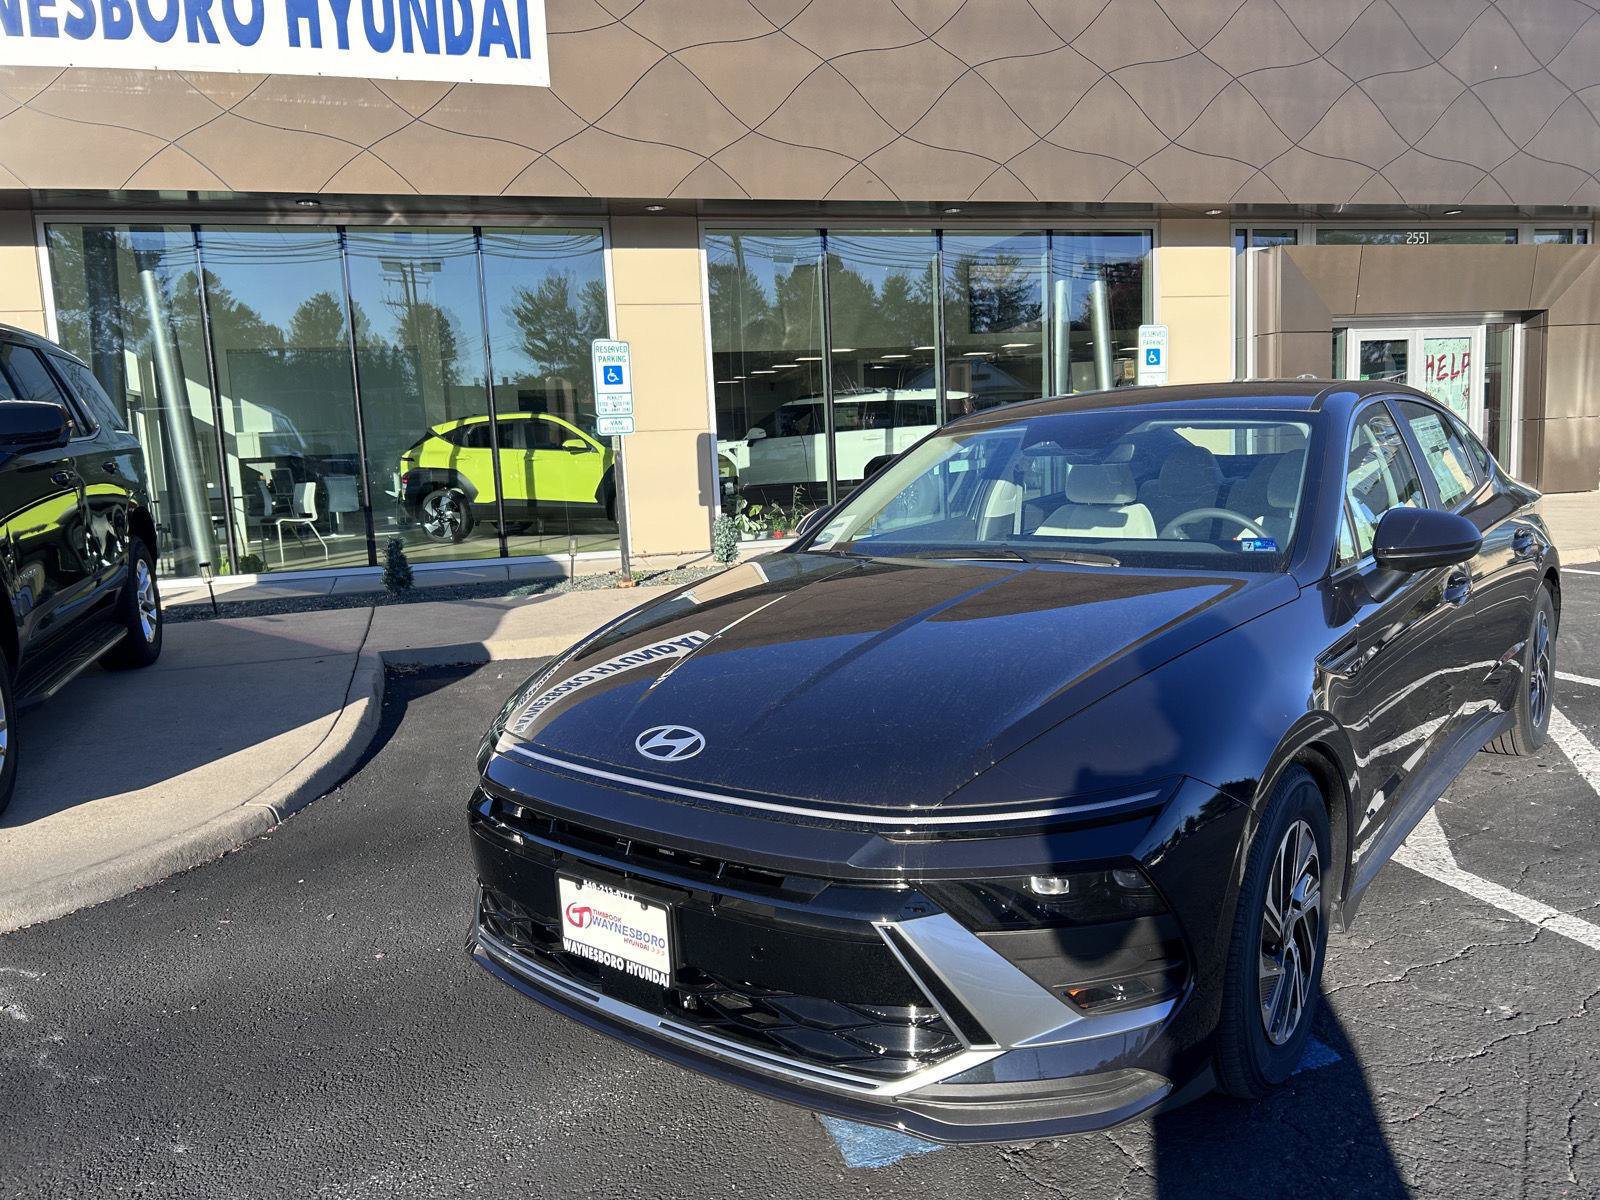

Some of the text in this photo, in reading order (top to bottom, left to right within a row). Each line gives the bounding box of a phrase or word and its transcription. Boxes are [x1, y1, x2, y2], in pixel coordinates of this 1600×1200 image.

[284, 0, 532, 60] HYUNDAI
[1406, 231, 1430, 245] 2551
[595, 345, 628, 354] RESERVED
[598, 355, 627, 363] PARKING
[1425, 352, 1471, 381] HELP
[593, 908, 622, 923] TIMBROOK
[592, 915, 666, 949] WAYNESBORO
[623, 937, 650, 951] HYUNDAI
[562, 937, 670, 988] WAYNESBORO HYUNDAI
